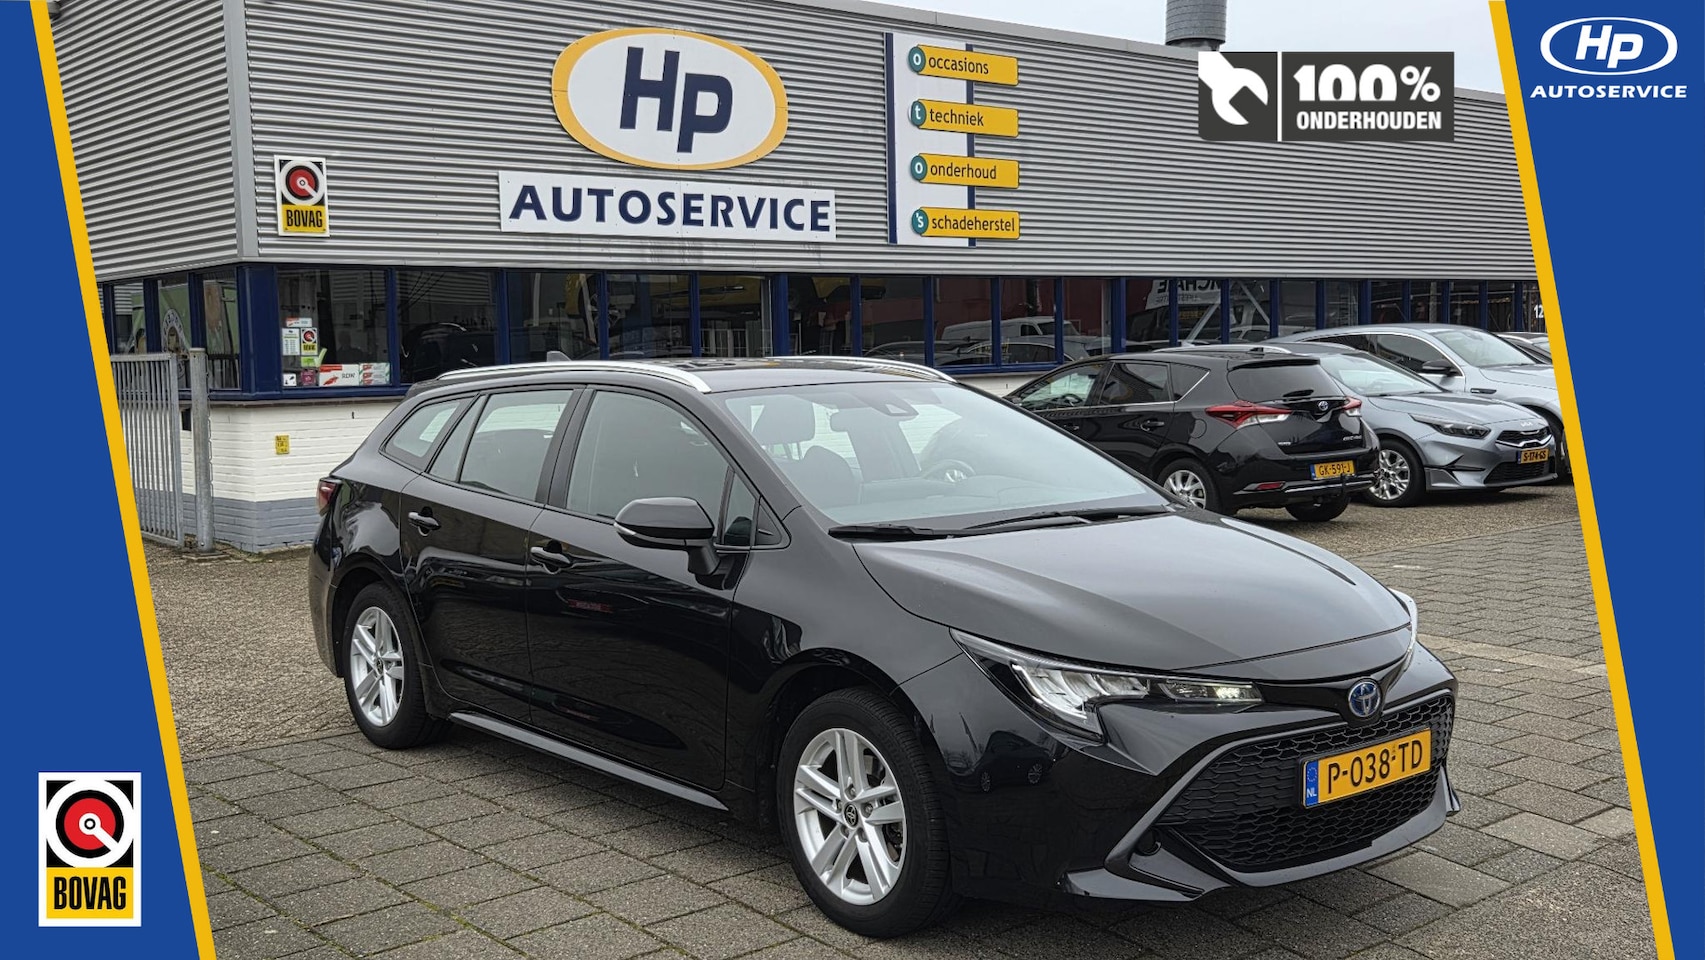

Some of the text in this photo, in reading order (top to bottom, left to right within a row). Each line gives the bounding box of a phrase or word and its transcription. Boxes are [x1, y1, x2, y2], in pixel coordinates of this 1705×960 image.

[928, 56, 989, 75] occasions
[929, 108, 984, 127] techniek
[930, 162, 997, 179] onderhoud
[509, 184, 831, 232] AUTOSERVICE
[286, 209, 323, 228] BOVAG
[931, 214, 1015, 232] schadeherstel
[1306, 740, 1423, 798] NL P-038-TD
